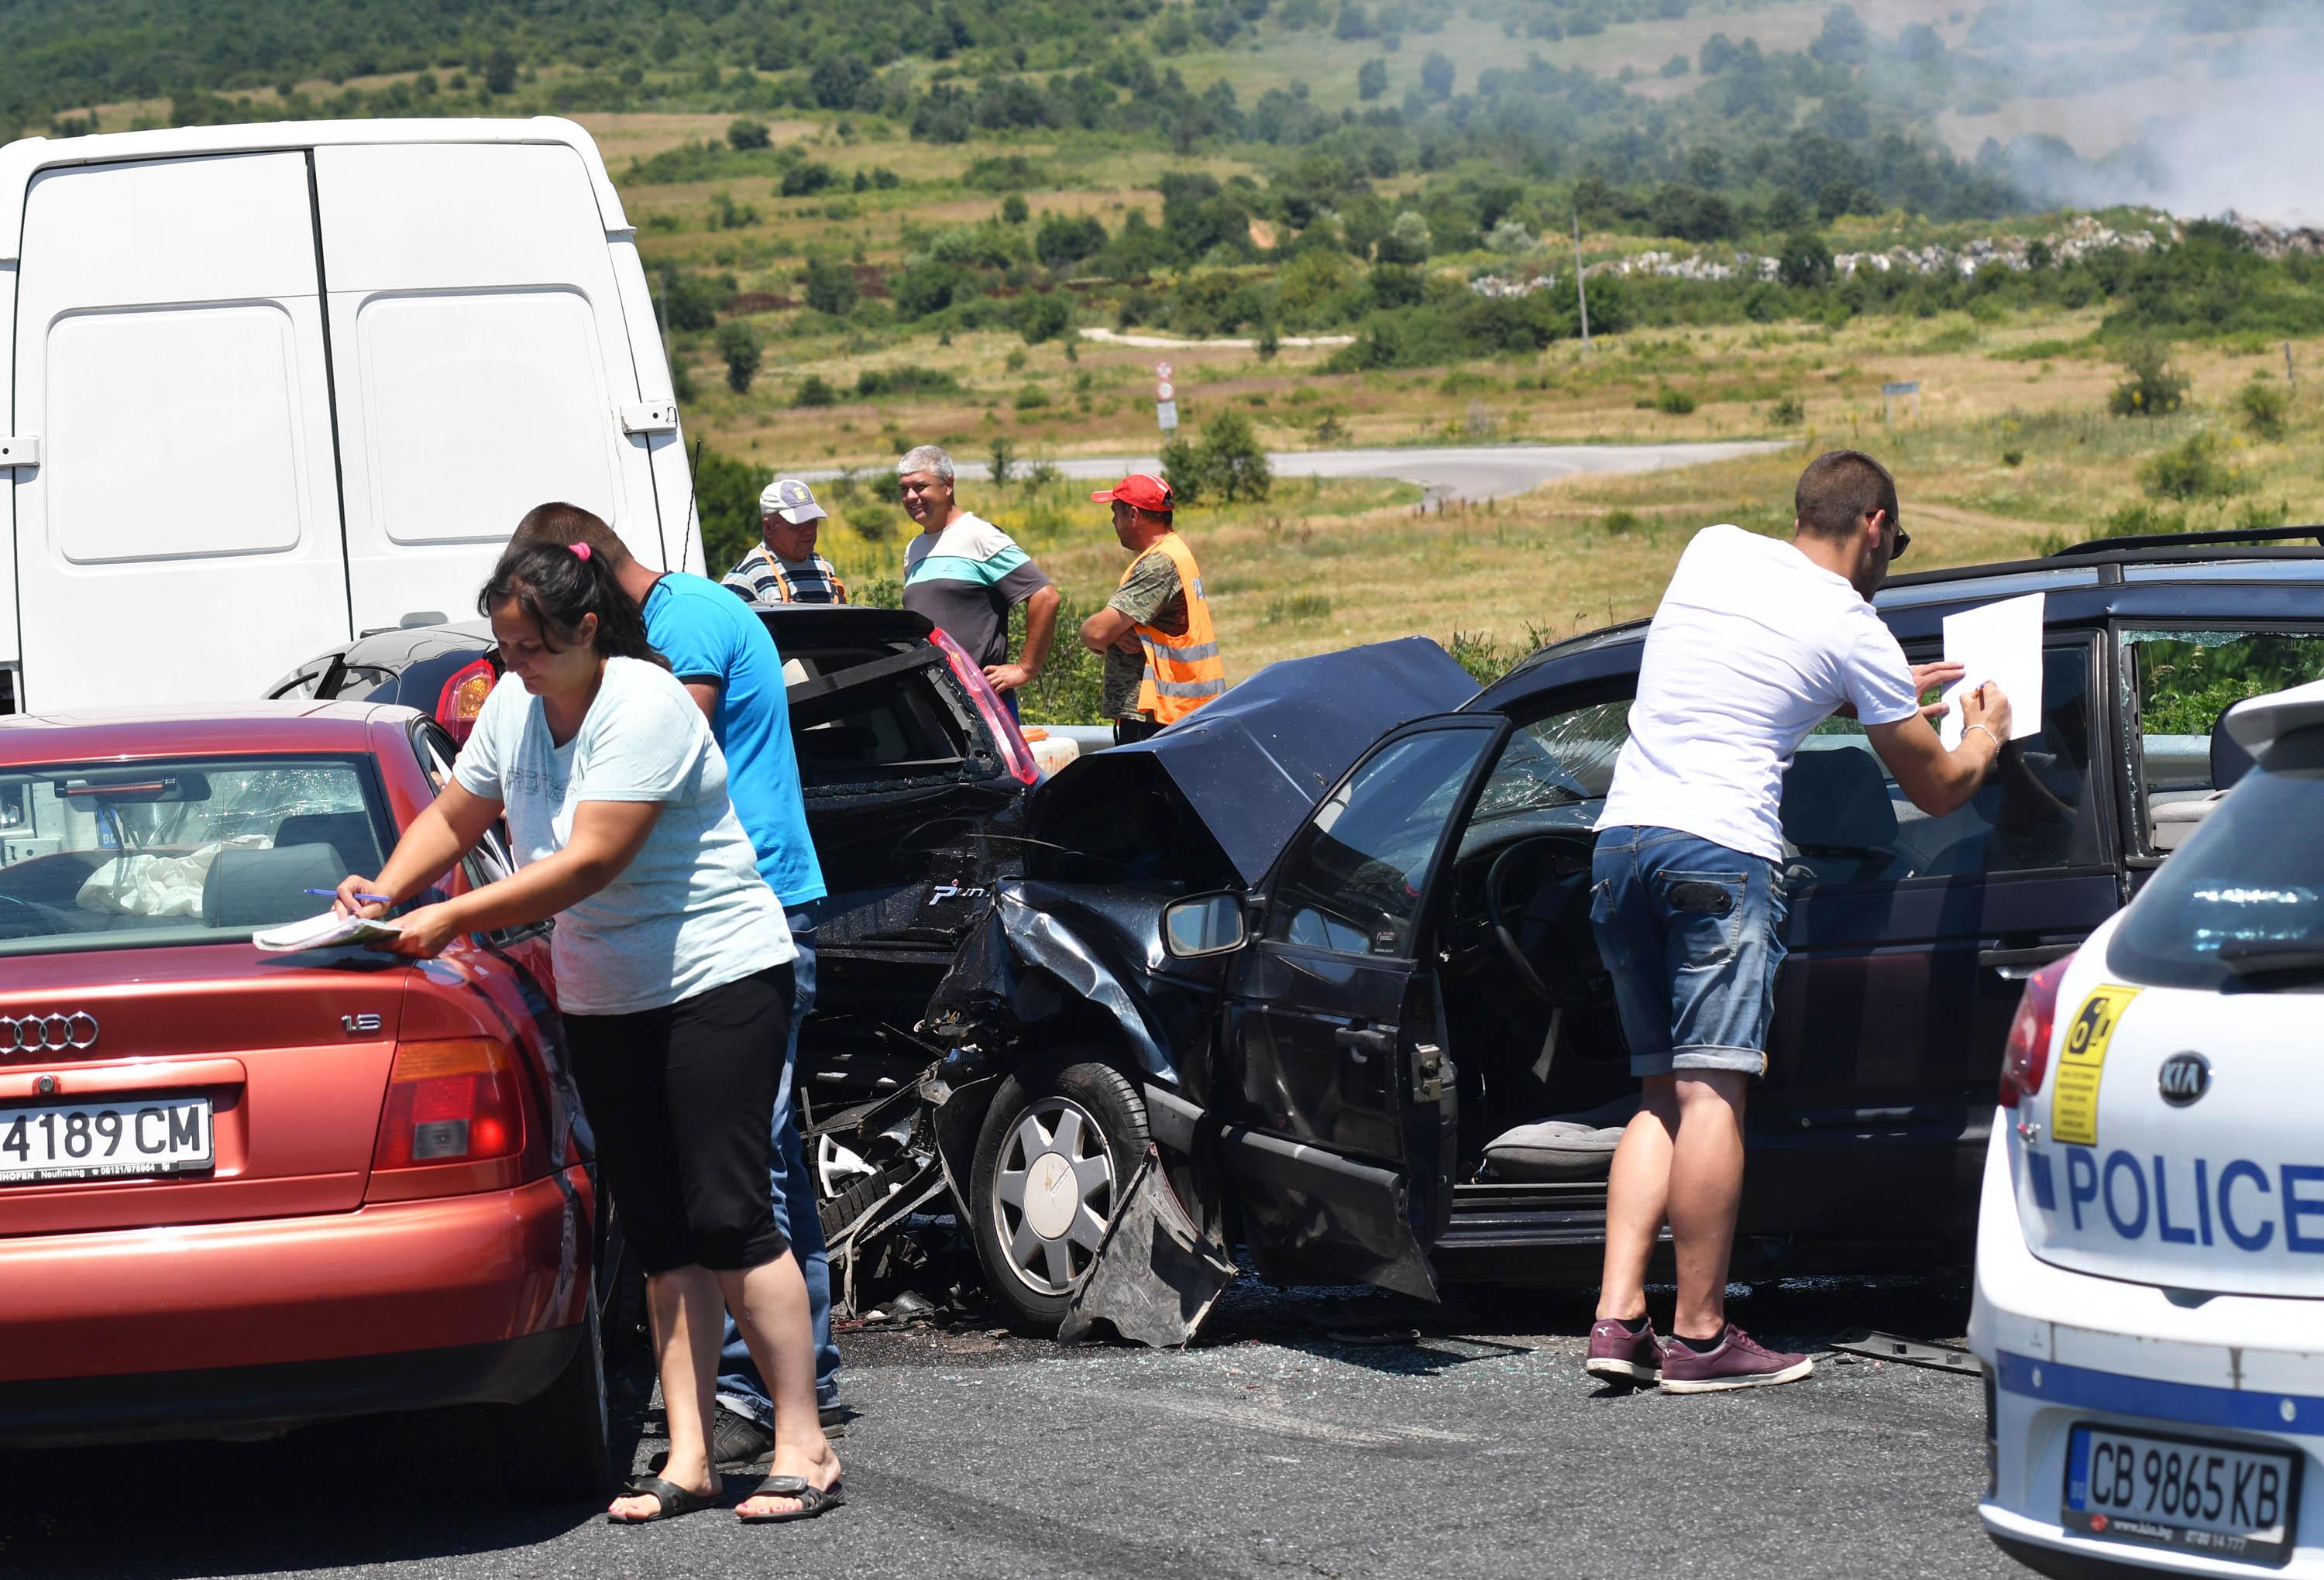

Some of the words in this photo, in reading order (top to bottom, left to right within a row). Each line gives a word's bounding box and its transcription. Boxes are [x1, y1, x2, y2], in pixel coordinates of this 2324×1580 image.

[2163, 1063, 2199, 1093] KIA
[2, 1110, 123, 1162] 4189
[135, 1105, 200, 1154] CM
[2066, 1146, 2324, 1254] POLICE
[2092, 1442, 2134, 1508] CB
[2144, 1449, 2224, 1521] 9865
[2231, 1460, 2280, 1529] KB
